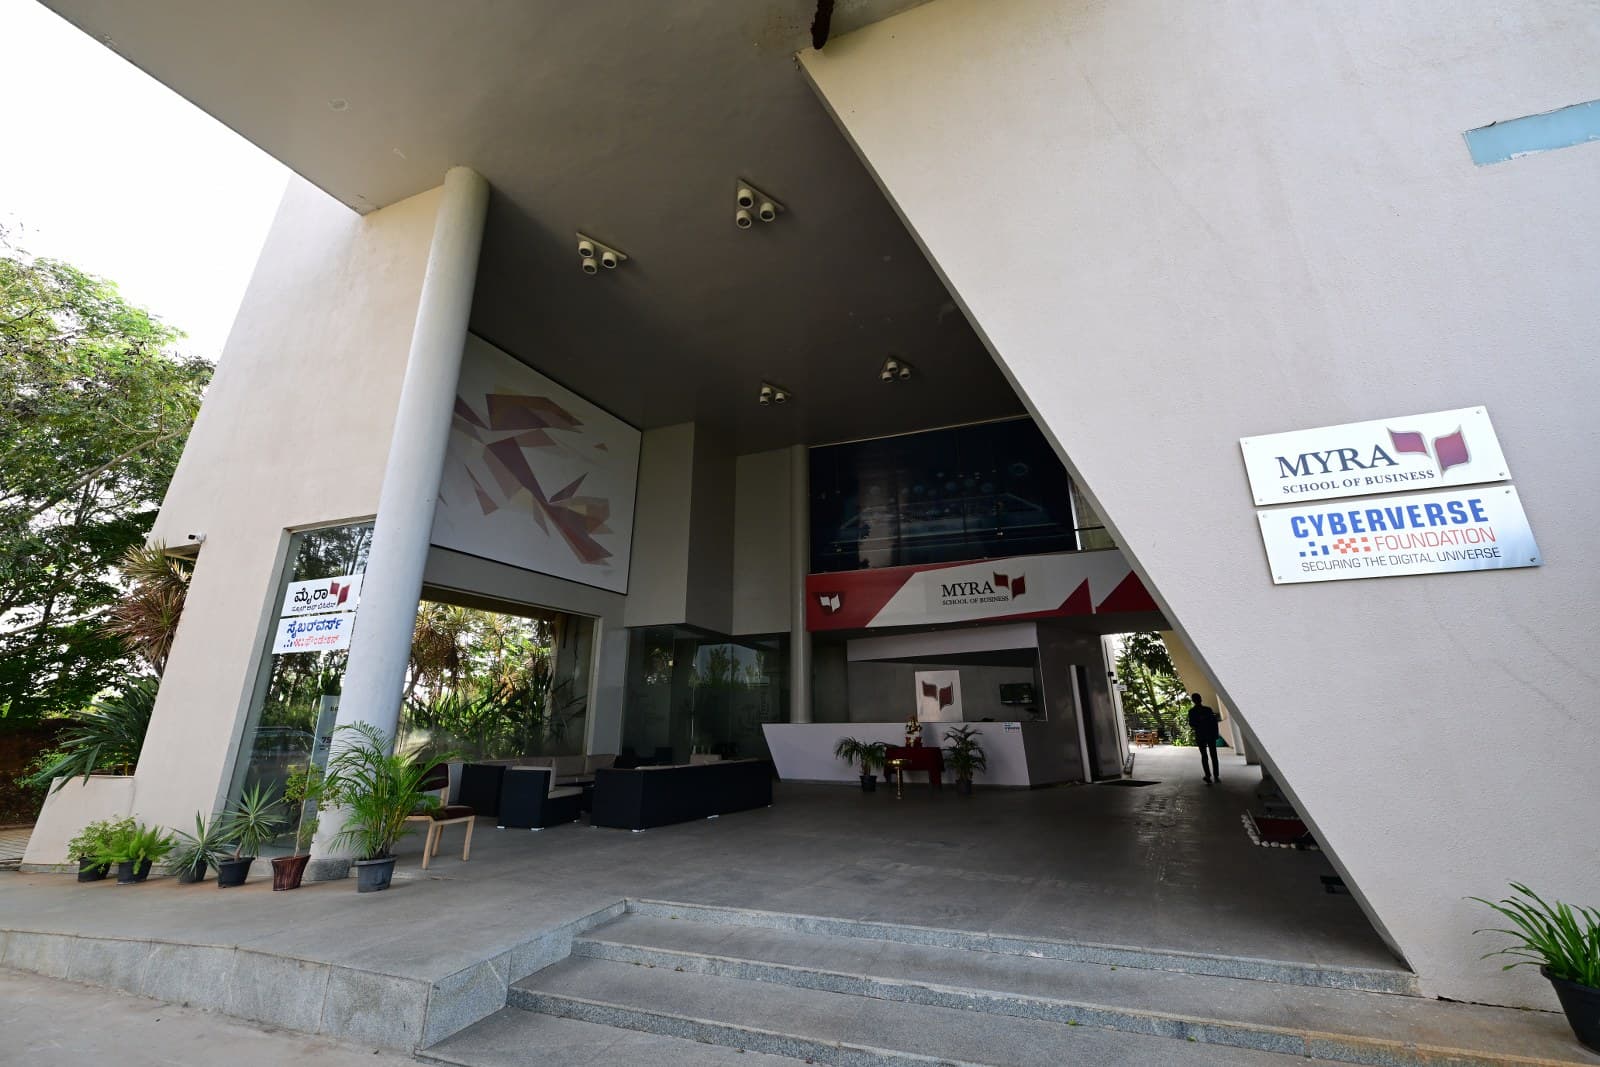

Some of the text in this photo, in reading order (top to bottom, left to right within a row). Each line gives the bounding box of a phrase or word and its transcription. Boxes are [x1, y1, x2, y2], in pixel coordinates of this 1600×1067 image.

[1274, 443, 1399, 479] MYRA
[1282, 469, 1435, 495] SCHOOL OF BUSINESS
[1290, 498, 1489, 539] CYBERVERSE
[1374, 526, 1496, 552] FOUNDATION
[1301, 546, 1502, 572] SECURING THE DIGITAL UNIVERSE
[294, 587, 328, 604] ಮೈರಾ
[941, 580, 995, 598] MYRA
[942, 598, 969, 606] SCHOOL
[980, 595, 1009, 603] BUSINESS
